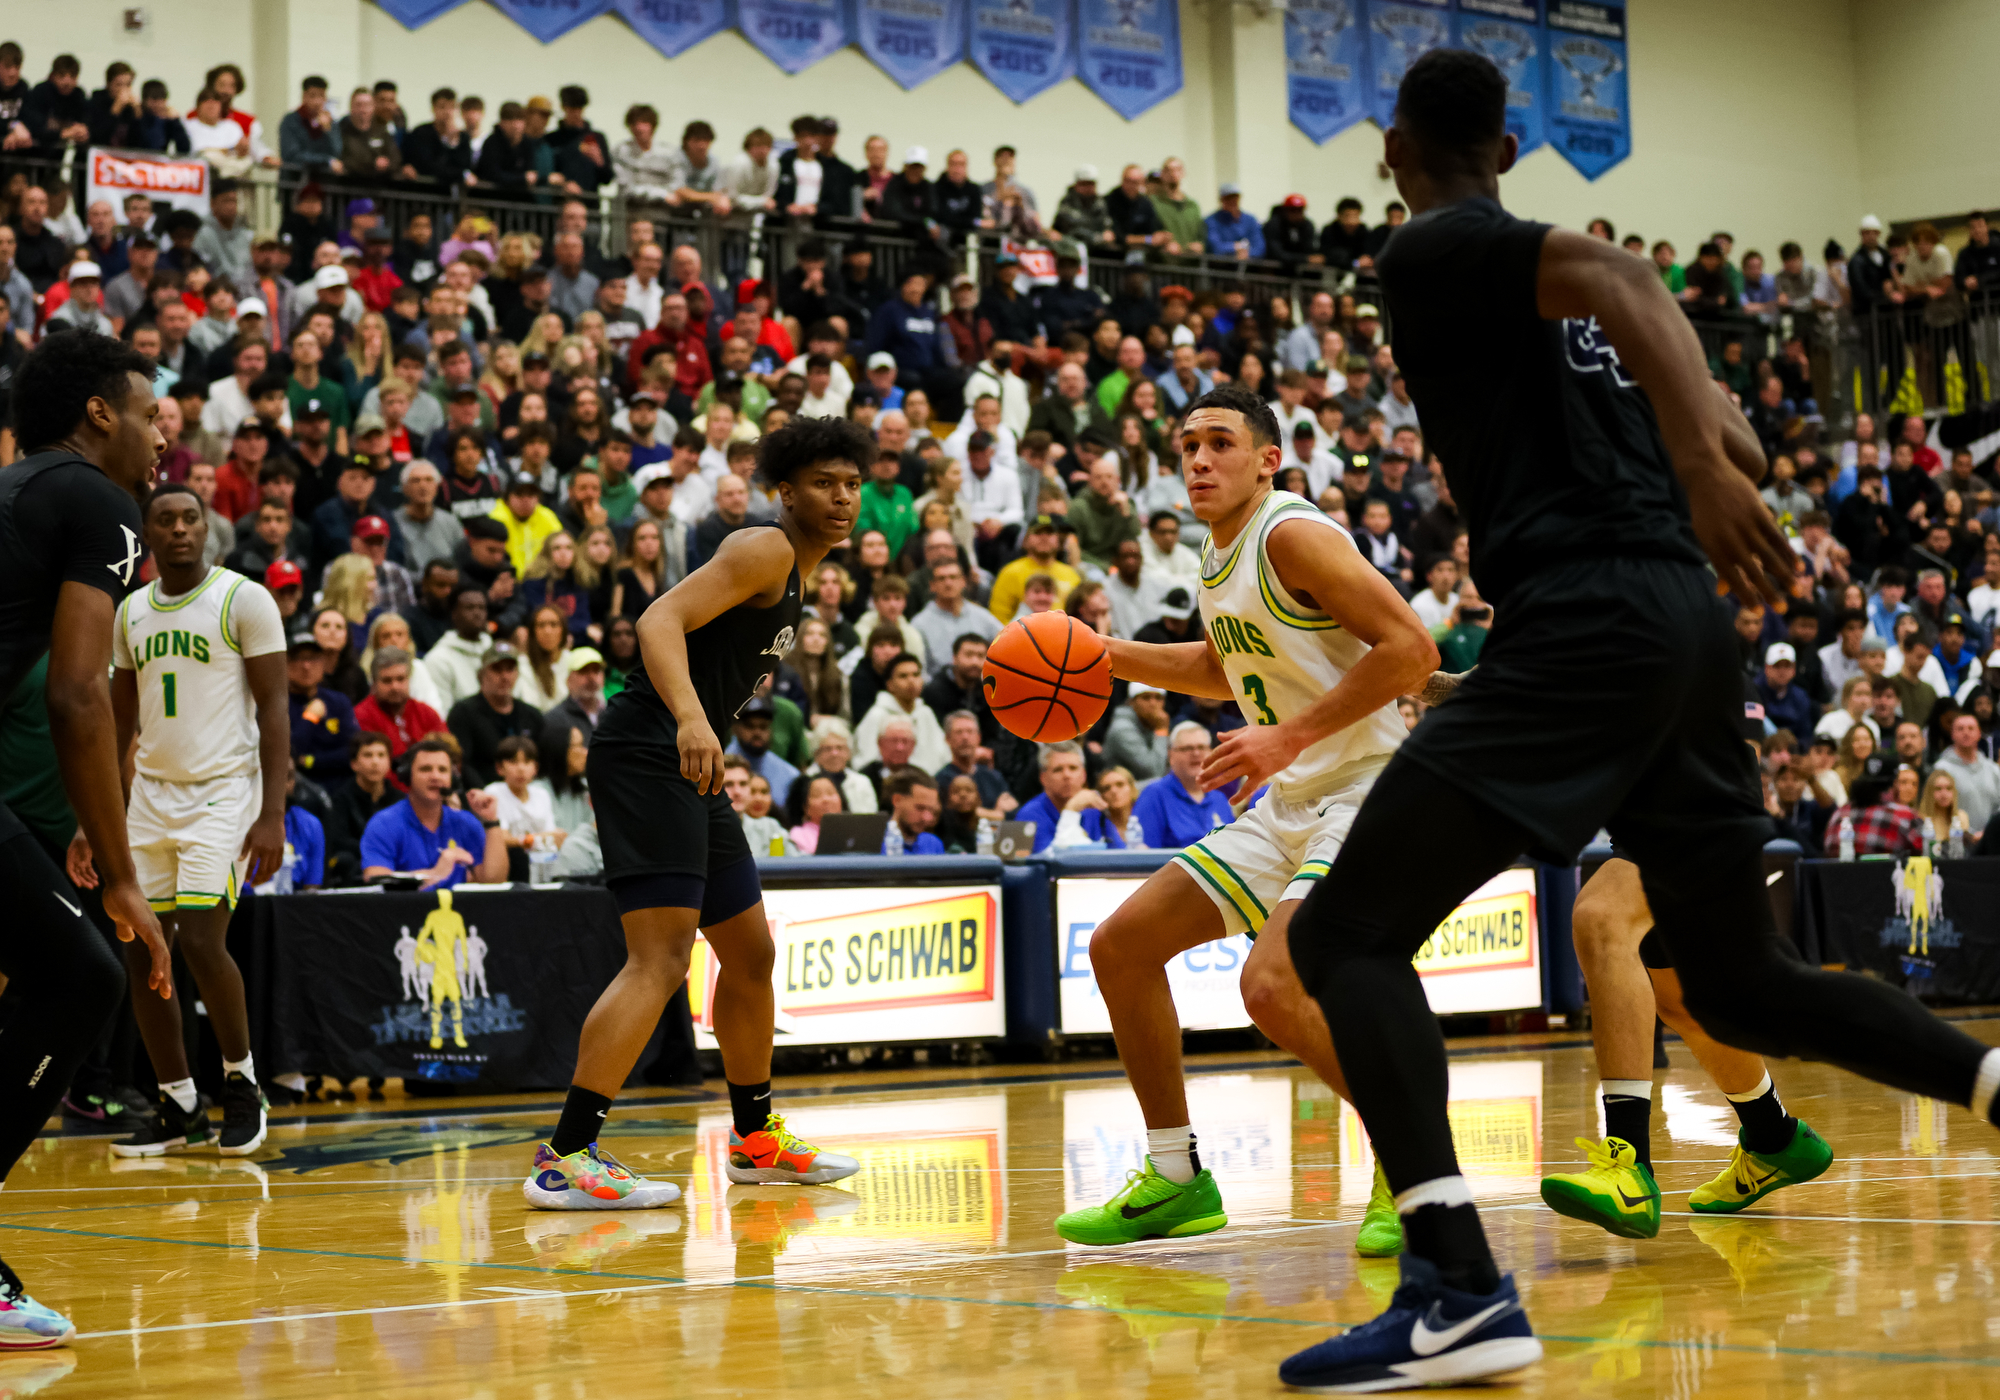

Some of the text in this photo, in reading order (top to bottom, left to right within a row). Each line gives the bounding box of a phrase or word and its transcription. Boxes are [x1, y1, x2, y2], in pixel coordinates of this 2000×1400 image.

[758, 15, 822, 41] 2014
[876, 30, 937, 60] 2015
[988, 46, 1049, 76] 2015
[99, 158, 201, 190] SECTION
[133, 629, 210, 672] LIONS
[1210, 615, 1276, 666] IONS
[161, 671, 178, 719] 1
[1241, 672, 1279, 726] 3
[786, 917, 977, 992] LES SCHWAB
[1441, 909, 1523, 957] SCHWAB
